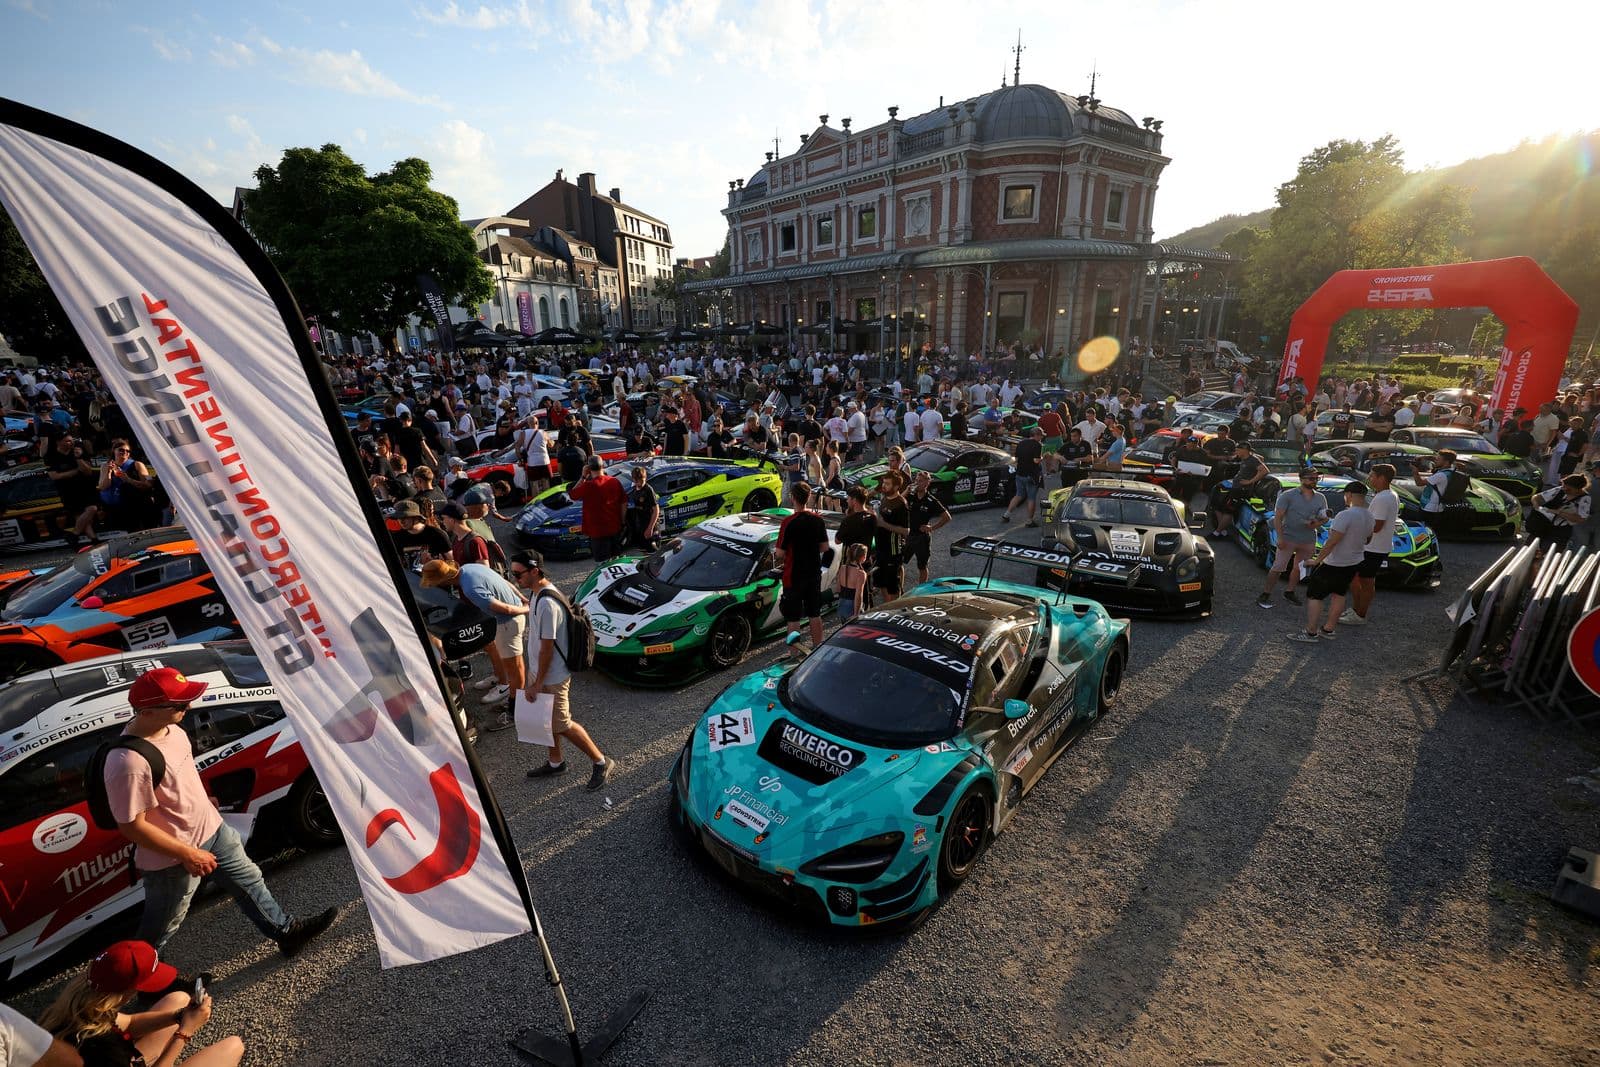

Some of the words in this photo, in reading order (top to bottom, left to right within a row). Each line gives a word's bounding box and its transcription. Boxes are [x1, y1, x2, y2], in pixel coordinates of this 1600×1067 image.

[1373, 274, 1434, 284] CROWDSTRIKE
[701, 534, 754, 556] WORLD
[1111, 552, 1152, 563] natural
[1094, 560, 1126, 573] GT
[127, 622, 170, 646] 59
[458, 624, 482, 638] aws
[864, 611, 890, 620] JP
[887, 614, 968, 644] Financial
[874, 636, 970, 674] WORLD
[217, 688, 277, 700] FULLWOO
[19, 716, 105, 753] McDERMOTT
[717, 713, 741, 746] 44
[1034, 734, 1048, 751] FOR
[1048, 720, 1062, 738] THE
[779, 741, 819, 767] RECYCLING
[783, 724, 854, 767] KIVERCO
[723, 784, 742, 797] JP
[738, 789, 790, 827] Financial
[730, 804, 766, 829] CROWDSTRIKE
